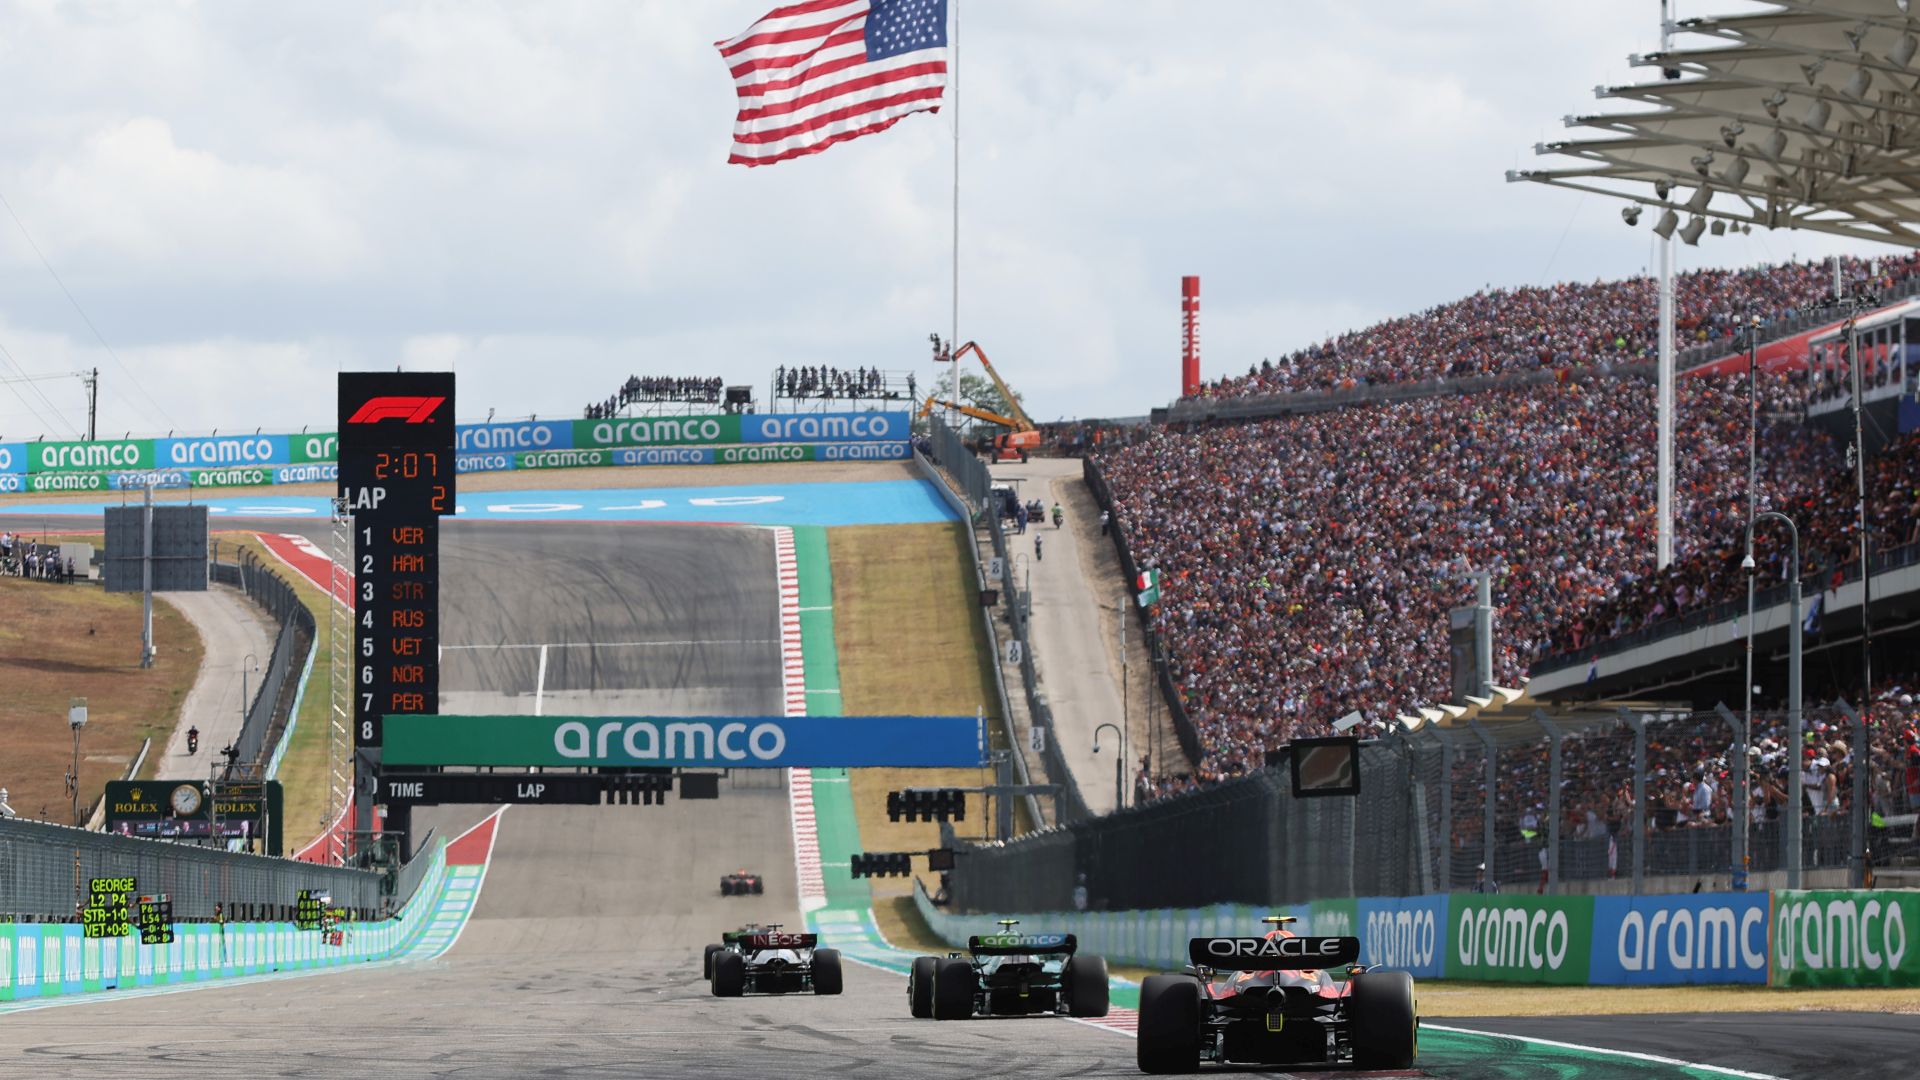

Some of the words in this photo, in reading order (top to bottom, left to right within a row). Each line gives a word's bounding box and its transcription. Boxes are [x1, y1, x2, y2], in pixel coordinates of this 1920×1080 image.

[347, 397, 446, 423] F1
[593, 418, 720, 442] aramco
[762, 416, 889, 439] aramco
[42, 444, 139, 467] aramco
[171, 439, 272, 463] aramco
[524, 452, 601, 467] aramco
[623, 448, 703, 464] aramco
[724, 445, 804, 462] aramco
[825, 442, 904, 459] aramco
[376, 453, 437, 478] 2:07
[456, 455, 506, 471] amco
[34, 475, 99, 490] aramco
[199, 470, 264, 486] aramco
[344, 487, 386, 509] LAP
[431, 486, 446, 511] 2
[362, 527, 373, 545] 1
[392, 528, 424, 544] VER
[362, 555, 373, 573] 2
[392, 555, 424, 572] HAM
[362, 582, 373, 601] 3
[392, 583, 424, 600] STR
[362, 610, 373, 628] 4
[392, 611, 424, 627] RUS
[362, 638, 373, 656] 5
[392, 638, 422, 655] VET
[362, 666, 373, 684] 6
[392, 666, 424, 683] NOR
[362, 694, 373, 711] 7
[392, 694, 424, 710] PER
[362, 721, 373, 739] 8
[554, 722, 785, 760] aramco
[389, 782, 423, 797] TIME
[517, 784, 545, 798] LAP
[115, 803, 158, 813] ROLEX
[215, 803, 257, 812] ROLEX
[92, 878, 134, 892] GEORGE
[91, 894, 105, 907] L2
[112, 893, 127, 906] P4
[142, 904, 153, 913] P6
[142, 914, 160, 923] L54
[753, 934, 802, 945] INEOS
[983, 934, 1062, 946] aramco
[1367, 909, 1434, 968] aramco
[1459, 906, 1568, 970] aramco
[1618, 906, 1770, 971] aramc
[1779, 899, 1906, 971] aramco
[1207, 938, 1340, 957] ORACLE
